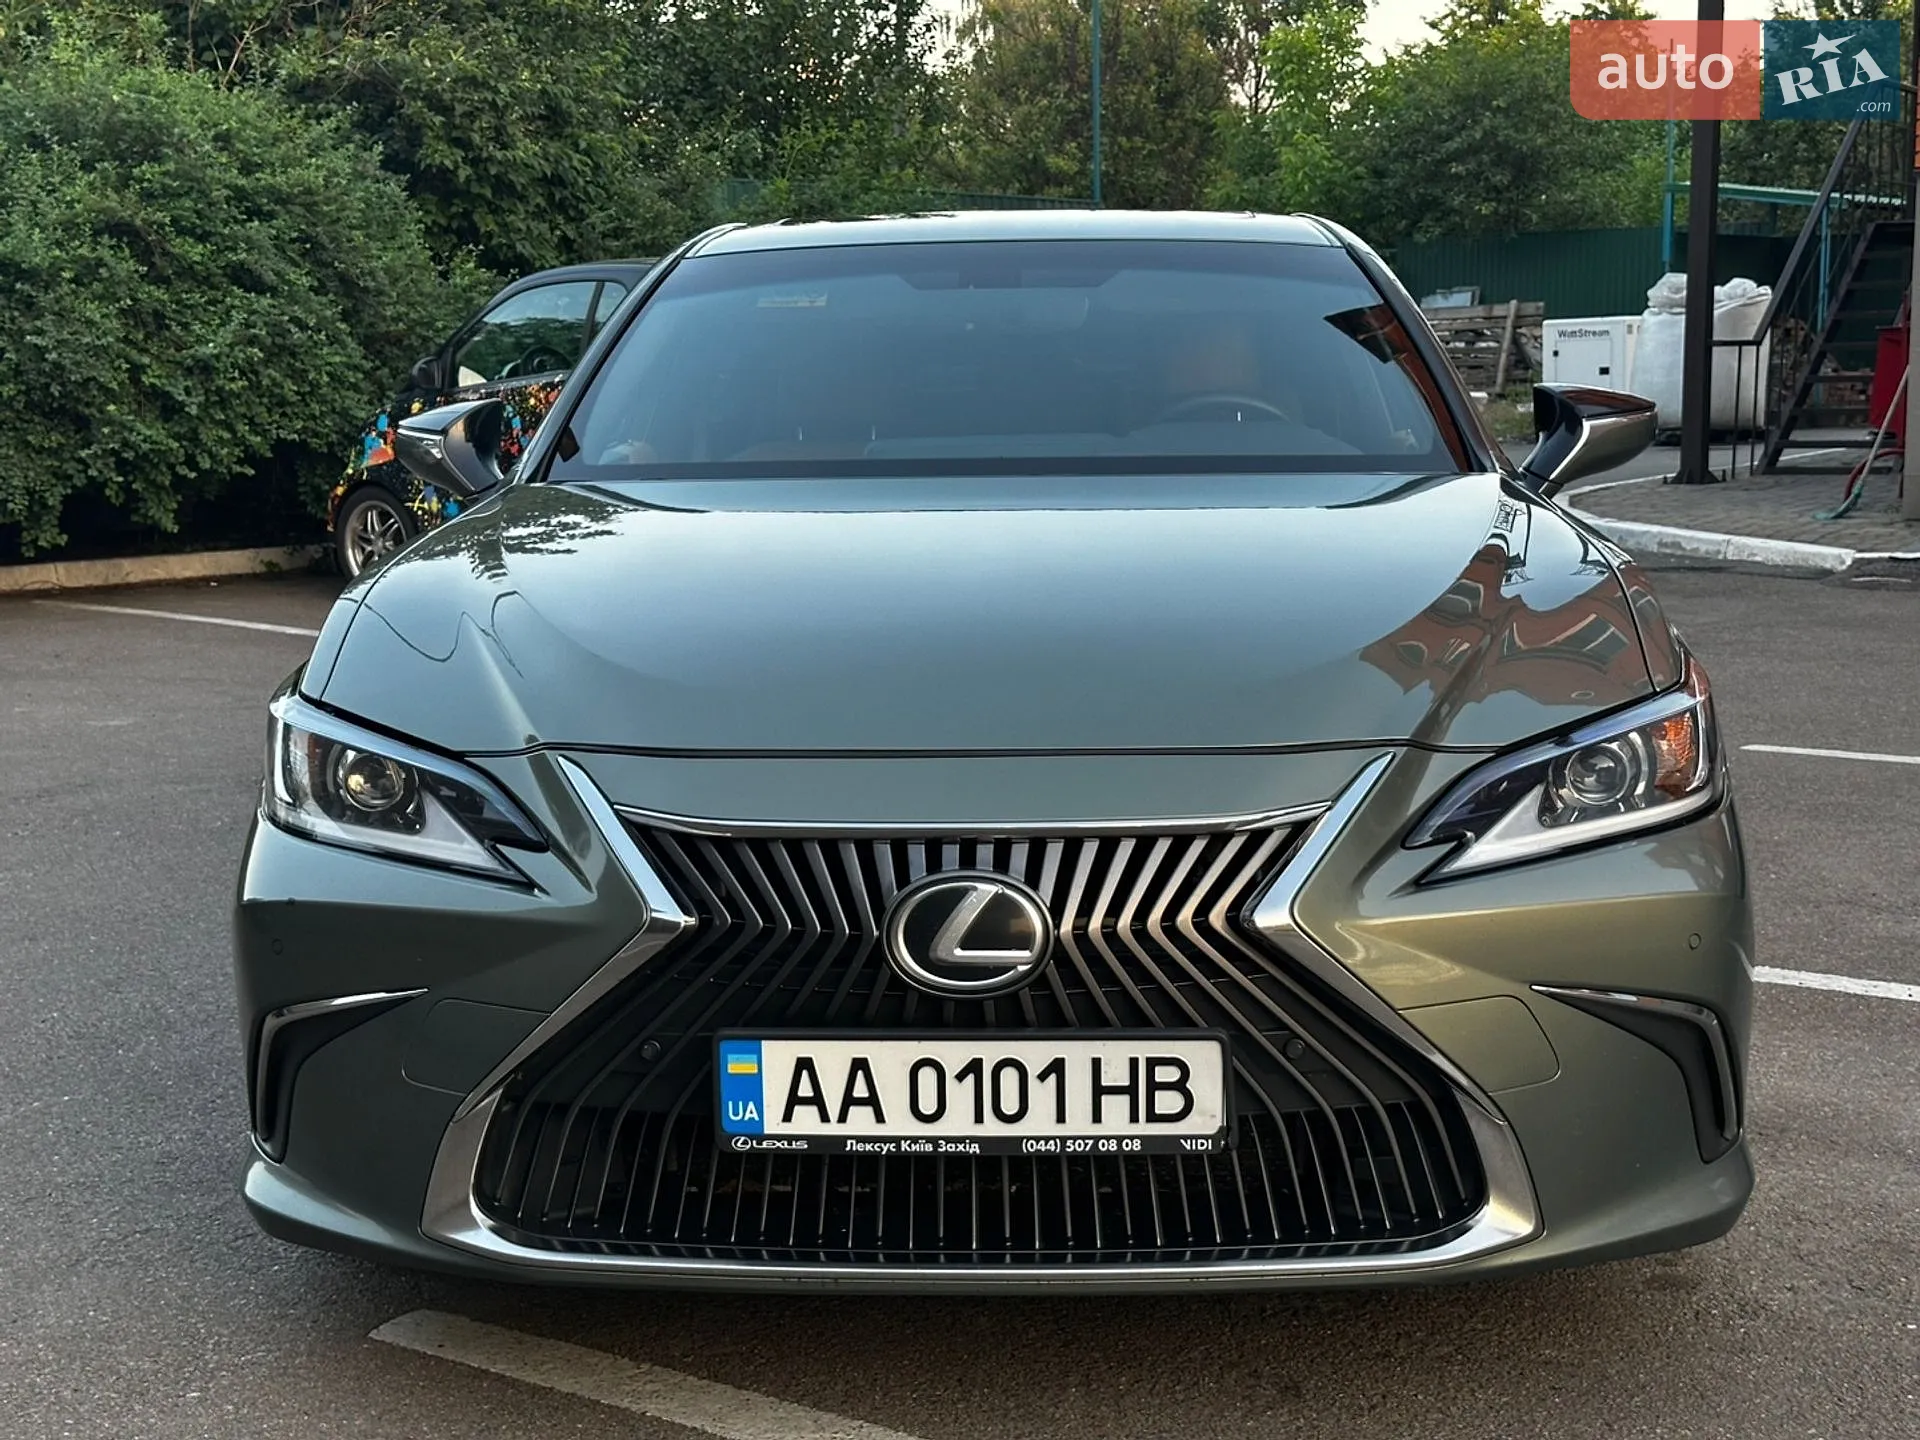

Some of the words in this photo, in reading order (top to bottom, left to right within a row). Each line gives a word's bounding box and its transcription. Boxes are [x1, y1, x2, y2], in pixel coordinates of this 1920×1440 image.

[1557, 327, 1610, 339] WattStream
[781, 1056, 886, 1124] AA
[908, 1057, 1067, 1125] 0101
[1091, 1056, 1195, 1125] HB
[728, 1101, 760, 1121] UA
[752, 1139, 809, 1150] LEXUS
[845, 1139, 897, 1155] Лексус
[901, 1139, 934, 1152] Київ
[937, 1139, 980, 1154] Захід
[1022, 1138, 1060, 1153] (044)
[1065, 1139, 1094, 1152] 507
[1098, 1139, 1118, 1151] 08
[1122, 1138, 1142, 1151] 08
[1180, 1138, 1213, 1150] VIDI
